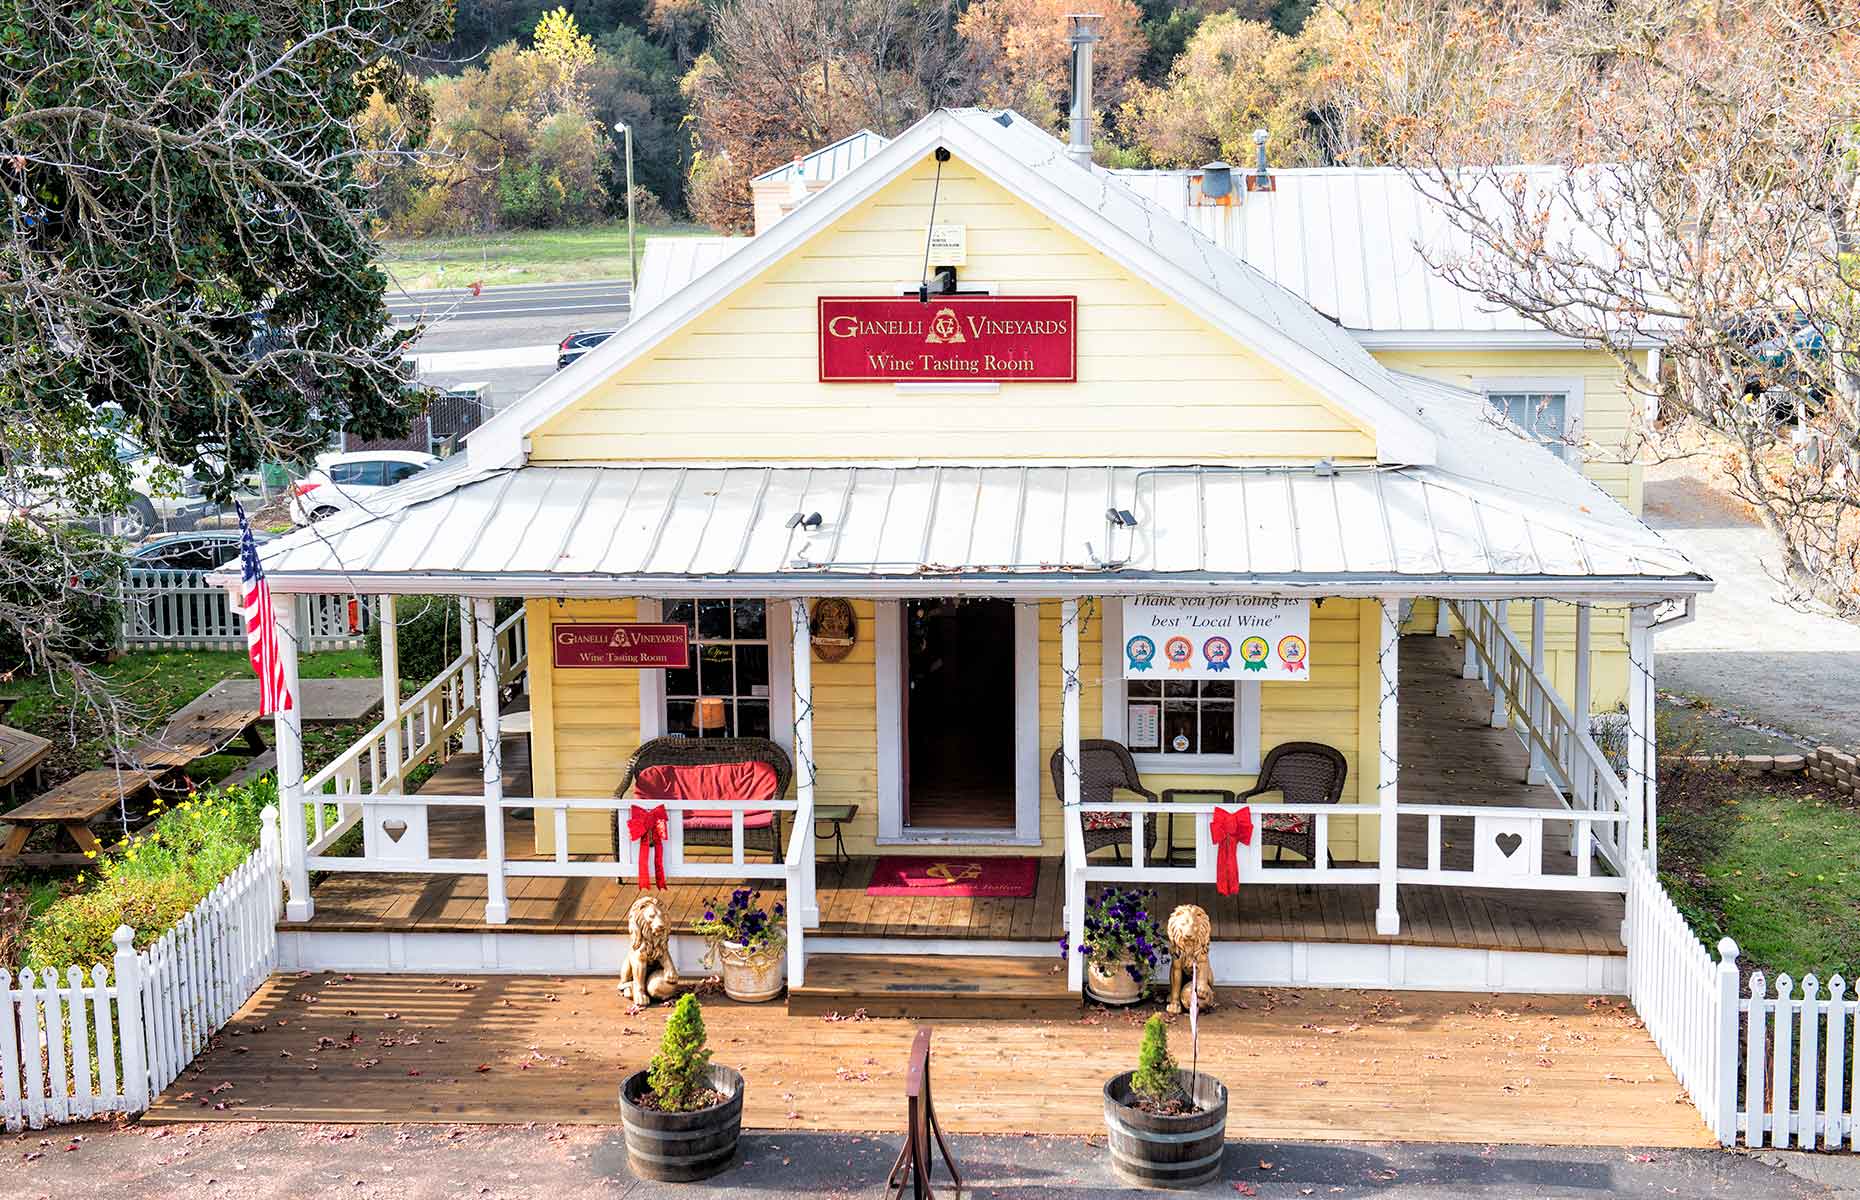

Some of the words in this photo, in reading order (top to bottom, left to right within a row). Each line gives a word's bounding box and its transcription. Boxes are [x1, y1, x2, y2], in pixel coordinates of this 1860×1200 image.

[828, 315, 923, 338] GIANELLI
[966, 315, 1068, 339] VINEYARDS
[869, 354, 914, 371] Wine
[918, 354, 979, 373] Tasting
[984, 354, 1034, 371] Room
[1180, 596, 1206, 610] you
[1208, 595, 1233, 610] for
[1151, 615, 1180, 628] best
[1186, 615, 1232, 628] "Local
[1237, 615, 1281, 628] Wine"
[558, 632, 608, 645] GIANELLI
[631, 632, 684, 646] VINEYARDS
[579, 652, 604, 662] Wine
[607, 652, 639, 664] Tasting
[639, 652, 667, 662] Room
